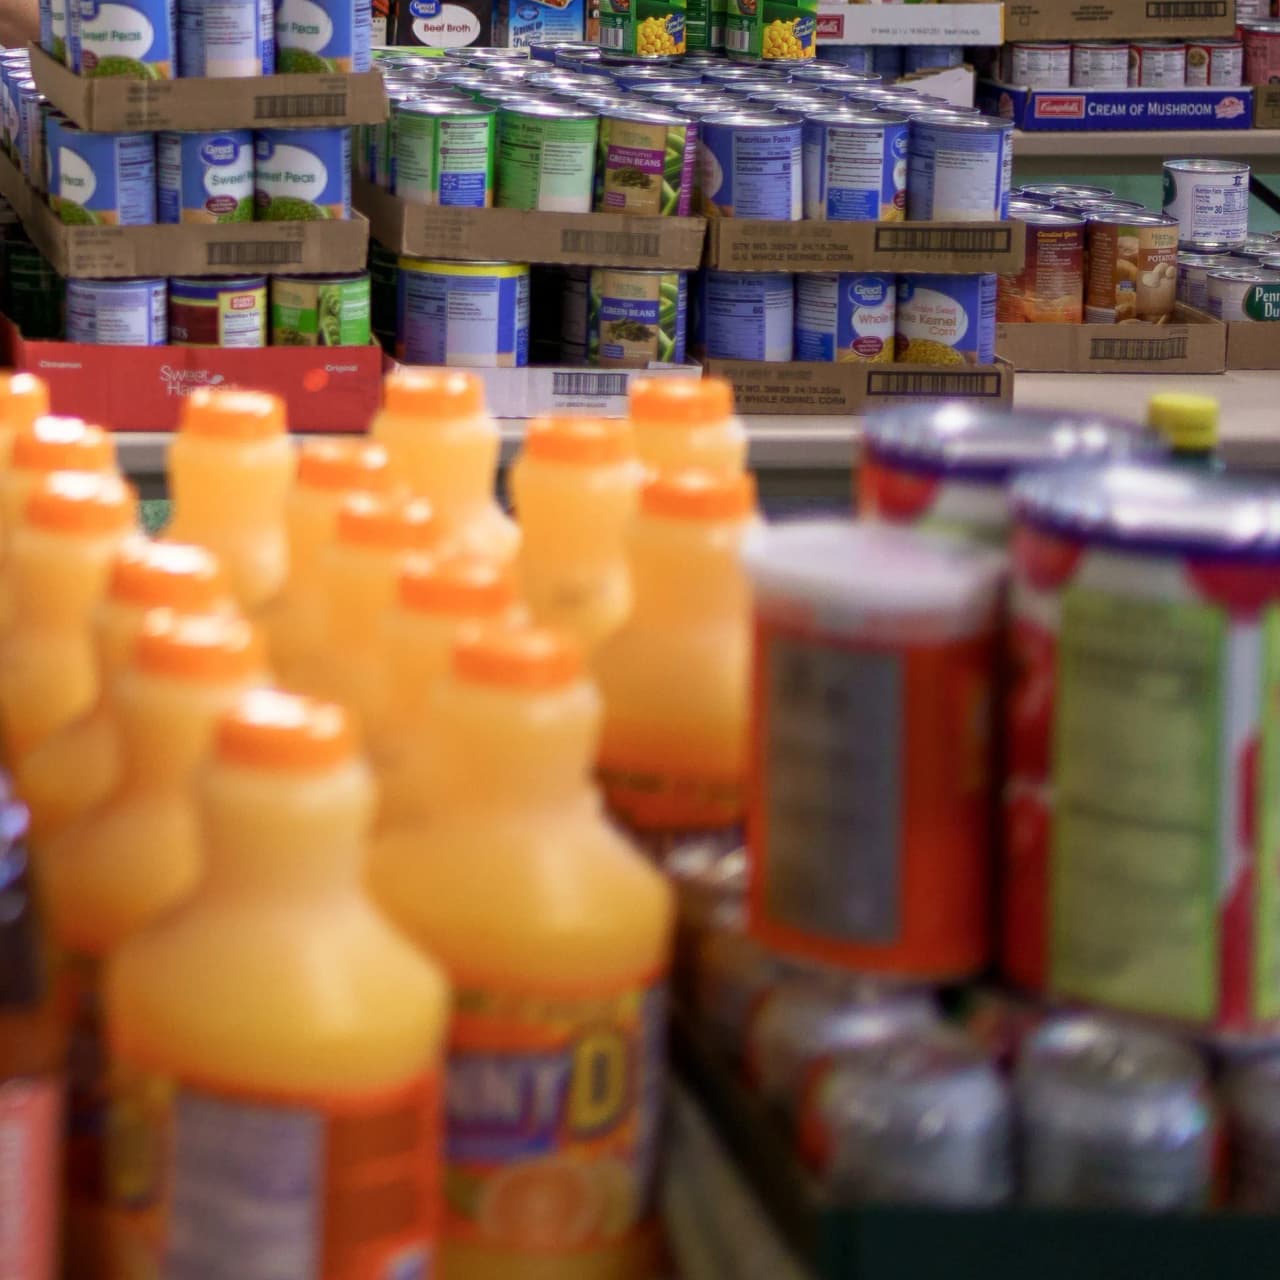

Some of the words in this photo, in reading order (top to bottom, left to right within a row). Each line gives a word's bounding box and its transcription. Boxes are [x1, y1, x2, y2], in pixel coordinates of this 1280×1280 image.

[292, 23, 320, 34] Peas
[423, 23, 444, 32] Beef
[446, 23, 471, 32] Broth
[112, 30, 142, 41] Peas
[1088, 102, 1126, 116] CREAM
[1129, 103, 1144, 115] OF
[1147, 102, 1212, 115] MUSHROOM
[737, 135, 771, 144] Nutrition
[205, 144, 234, 155] Great
[609, 154, 633, 165] GREEN
[634, 157, 661, 168] BEANS
[285, 171, 315, 183] Peas
[1214, 205, 1223, 214] 30
[854, 284, 882, 294] Great
[629, 309, 656, 318] BEANS
[920, 316, 957, 327] Kernel
[929, 326, 957, 336] Corn
[39, 361, 82, 369] Cinnamon
[325, 365, 358, 373] Original
[160, 365, 209, 382] Sweet
[744, 395, 777, 403] WHOLE
[780, 395, 815, 404] KERNEL
[819, 396, 846, 405] CORN
